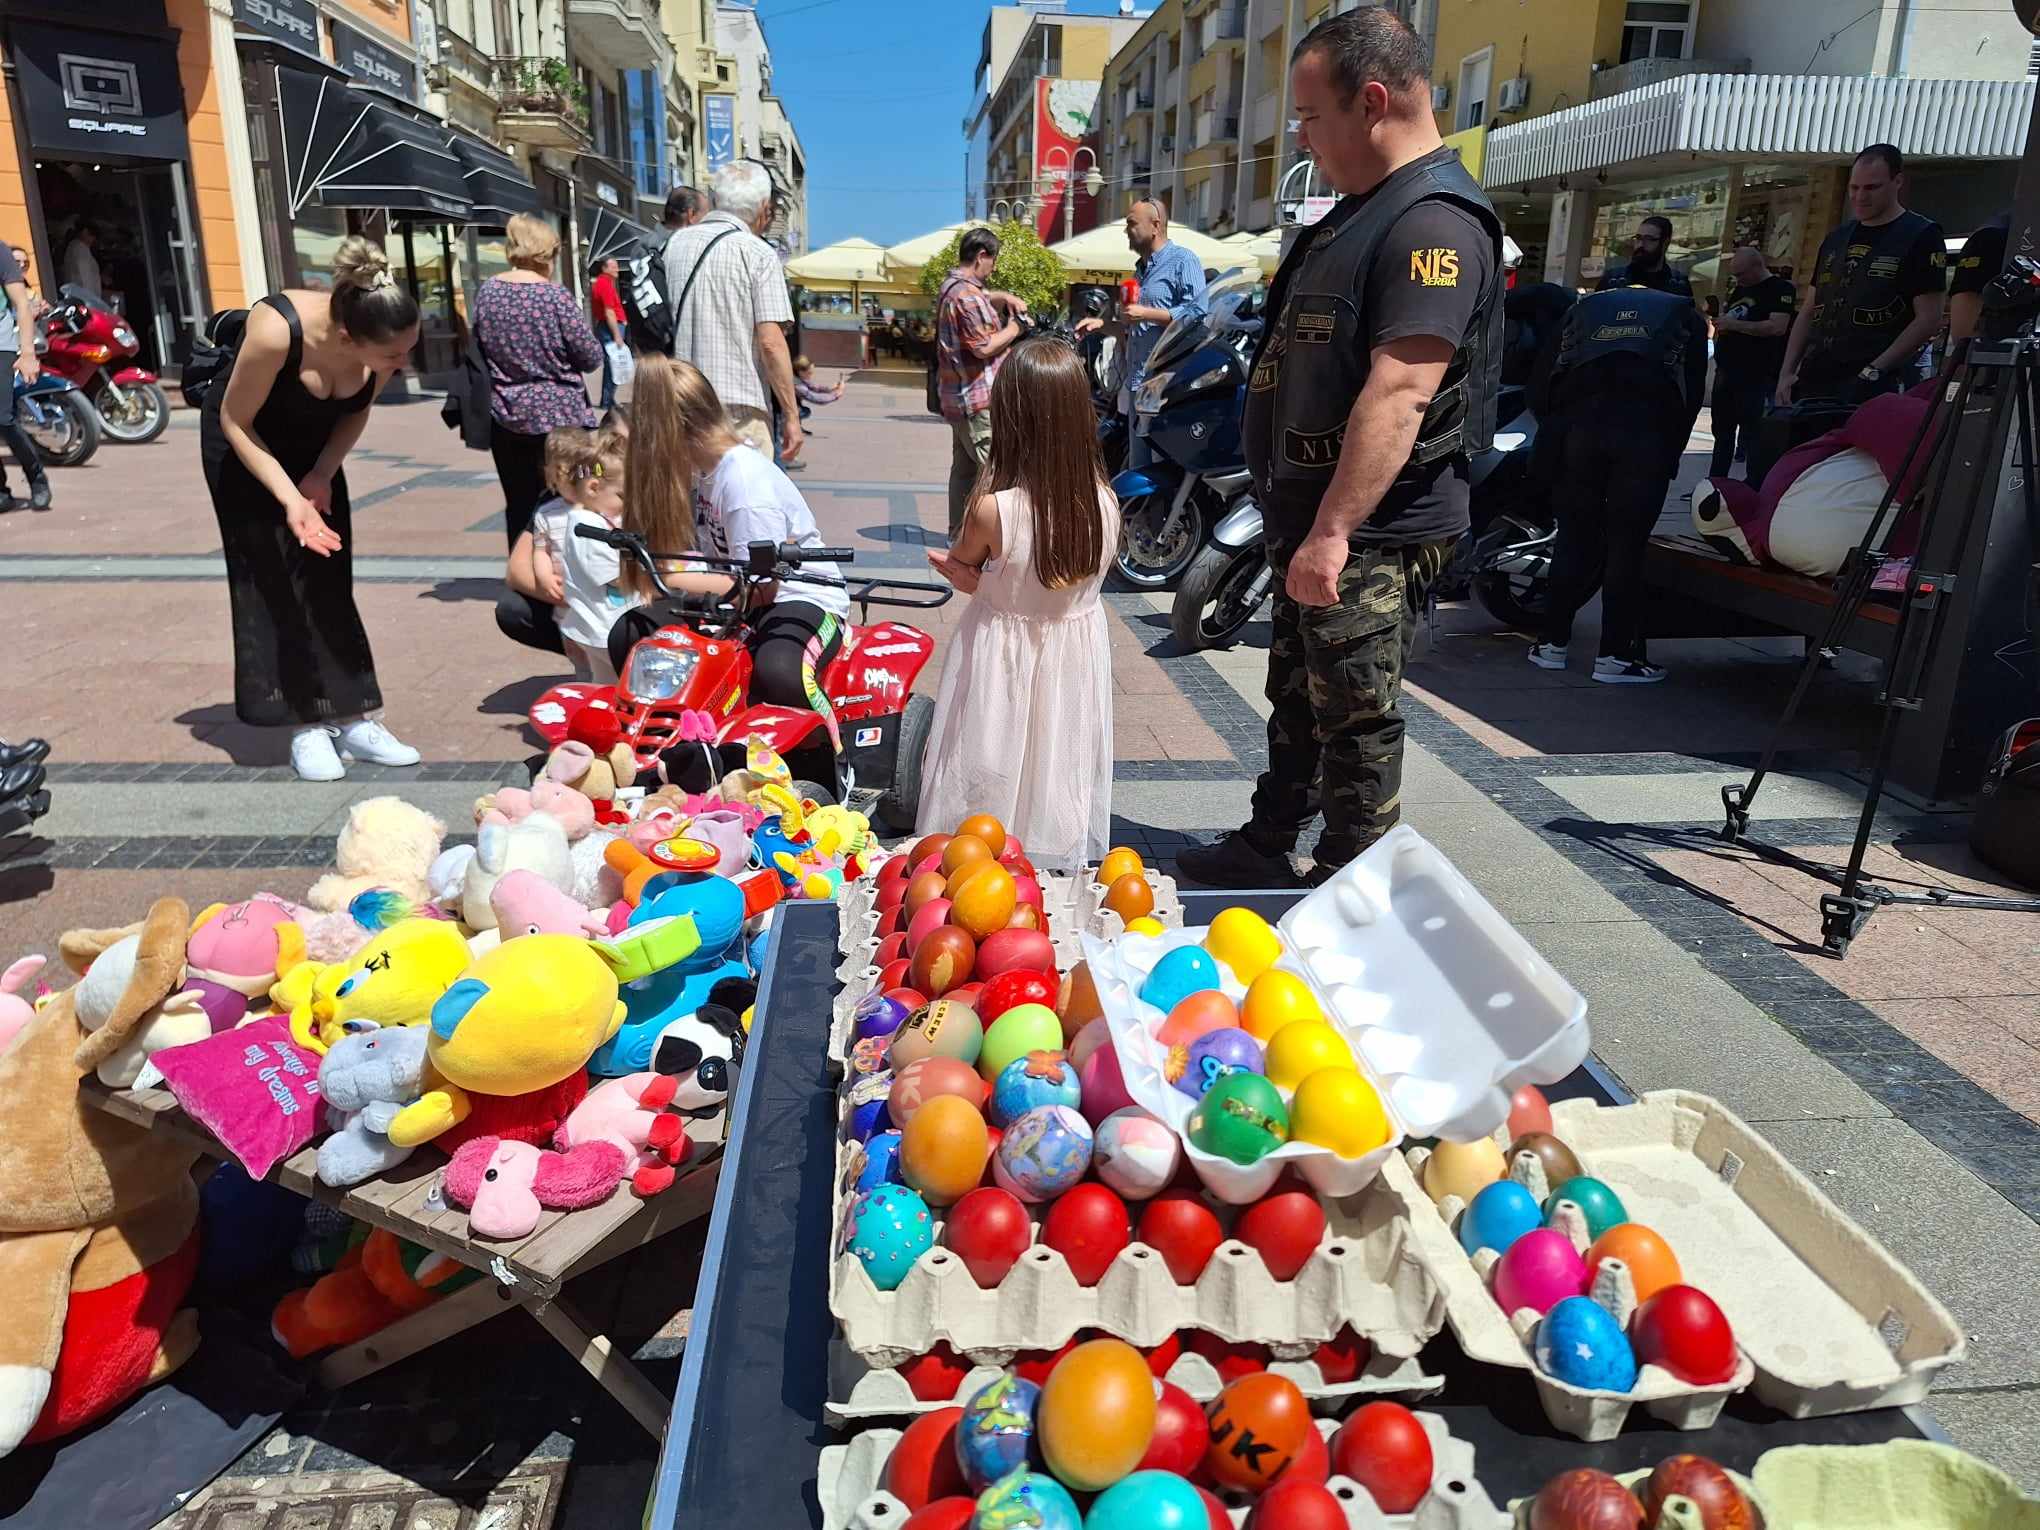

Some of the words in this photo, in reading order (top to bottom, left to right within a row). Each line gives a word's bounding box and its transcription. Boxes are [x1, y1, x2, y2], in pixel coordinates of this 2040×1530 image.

[1421, 277, 1457, 288] SERBIA
[243, 1044, 269, 1067] my
[258, 1065, 300, 1116] dreams
